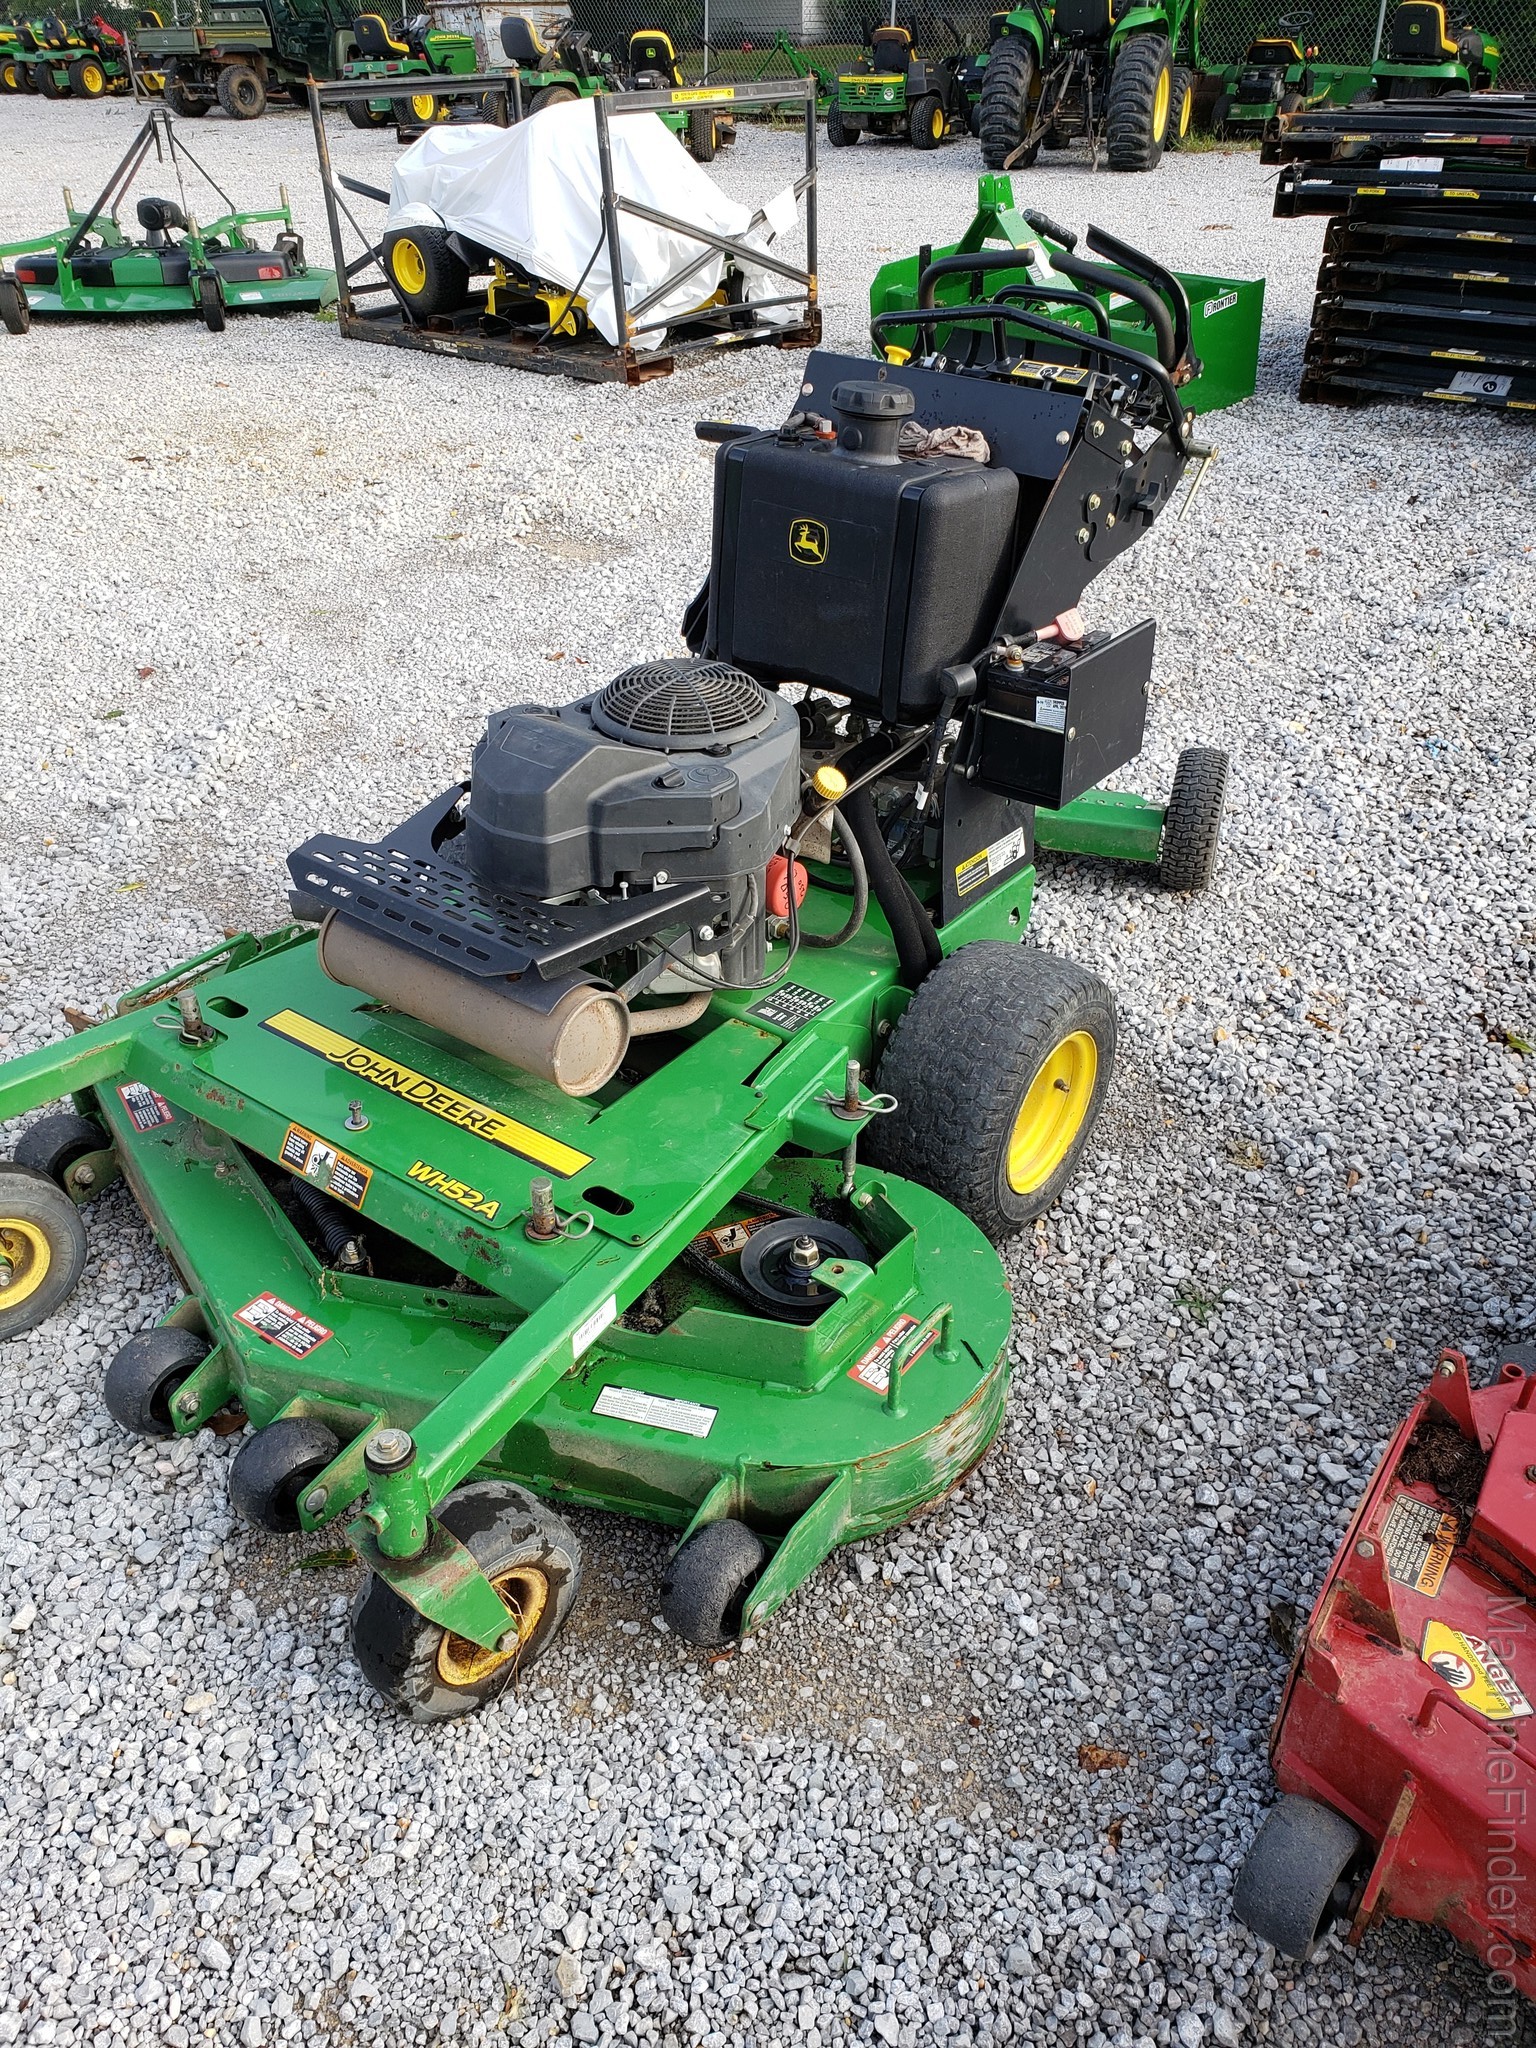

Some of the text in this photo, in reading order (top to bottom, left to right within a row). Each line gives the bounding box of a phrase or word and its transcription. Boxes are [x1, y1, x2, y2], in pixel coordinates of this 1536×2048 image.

[328, 1046, 506, 1140] JOHN DEERE
[406, 1160, 502, 1221] WH52A
[274, 1300, 296, 1315] DANGER
[304, 1318, 328, 1335] PELIGRO
[886, 1318, 907, 1337] PELIGRO
[860, 1345, 882, 1364] DANGER
[1420, 1533, 1450, 1588] WARNING
[1460, 1640, 1475, 1662] HANDS
[1474, 1662, 1486, 1675] and
[1482, 1675, 1496, 1692] FEET
[1466, 1636, 1523, 1706] ANGER
